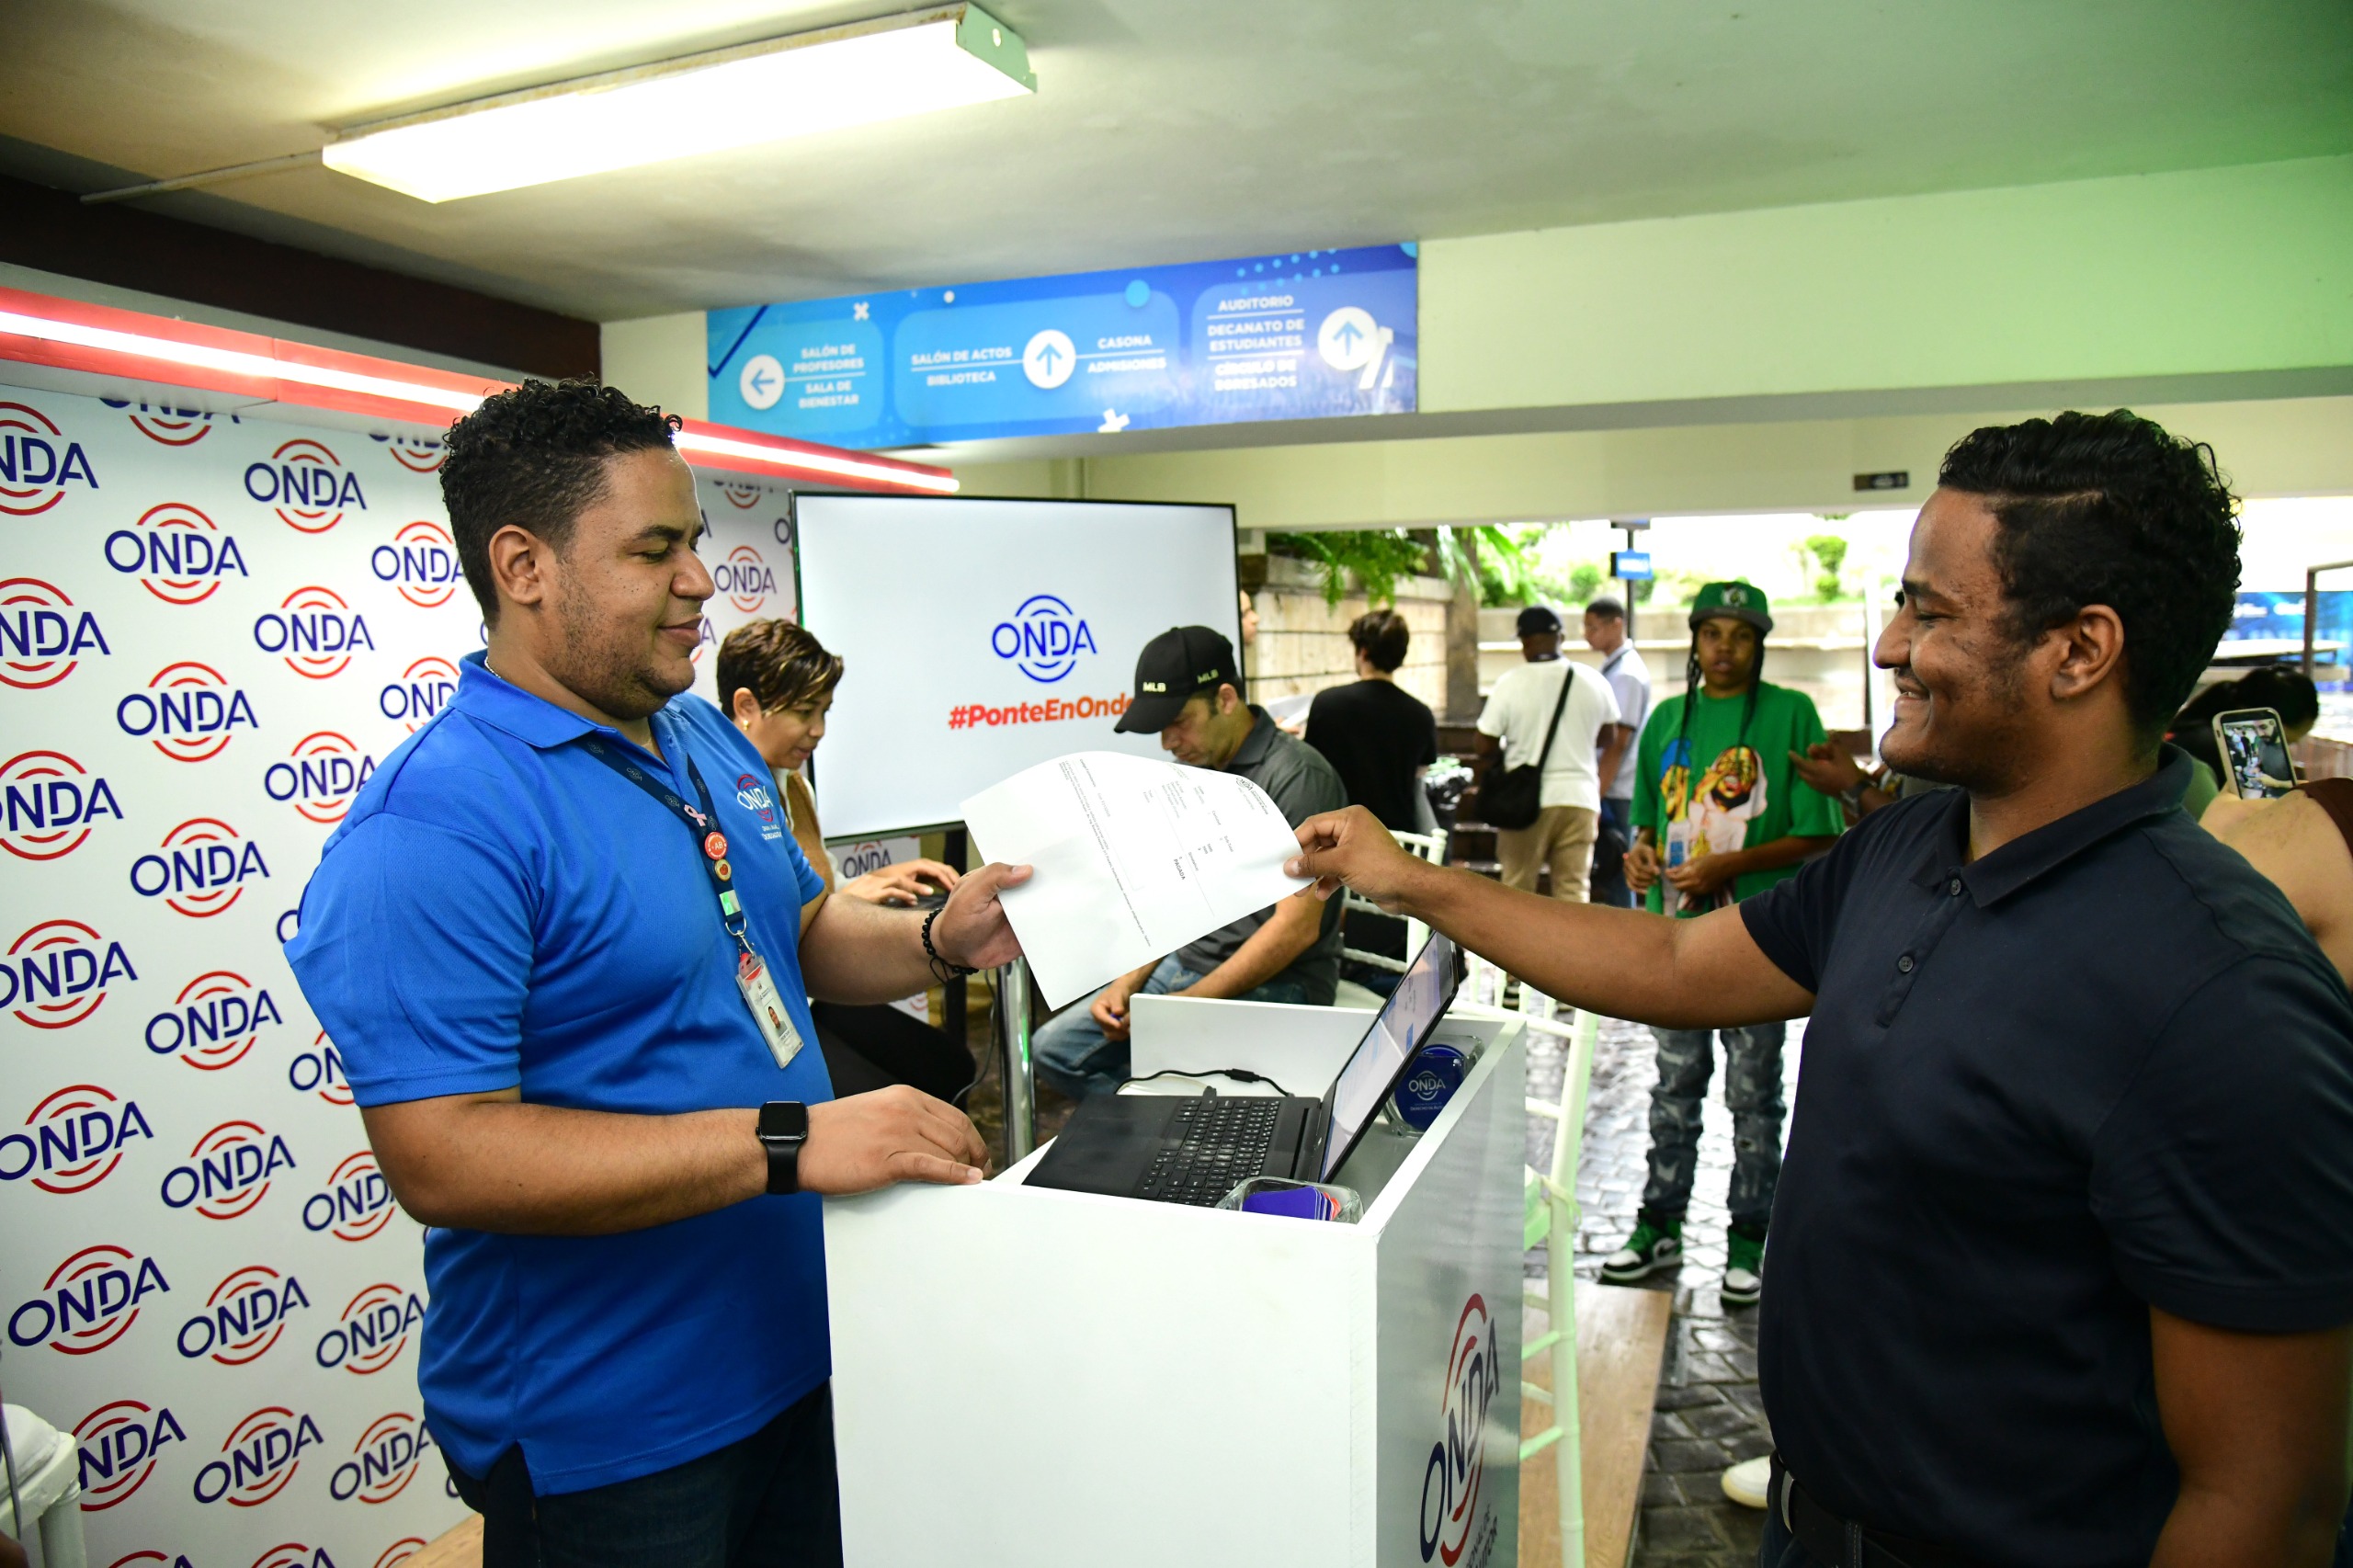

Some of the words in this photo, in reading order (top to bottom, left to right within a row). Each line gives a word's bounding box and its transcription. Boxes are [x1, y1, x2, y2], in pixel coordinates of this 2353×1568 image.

[1218, 295, 1294, 312] AUDITORIO
[1097, 334, 1153, 349] CASONA
[1207, 320, 1283, 336] DECANATO
[1285, 318, 1305, 331] DE
[1210, 335, 1302, 352] ESTUDIANTES
[793, 358, 864, 373] PROFESORES
[801, 344, 839, 359] SALÓN
[840, 343, 856, 356] DE
[912, 349, 951, 365] SALÓN
[953, 350, 970, 362] DE
[972, 347, 1013, 360] ACTOS
[1277, 358, 1297, 372] DE
[806, 381, 835, 394] SALA
[836, 380, 852, 392] DE
[926, 370, 996, 386] BIBLIOTECA
[1214, 375, 1297, 392] EGRESADOS
[799, 394, 859, 409] BIENESTAR
[245, 462, 367, 510] ONDA
[105, 530, 248, 577] ONDA
[714, 565, 777, 594] ONDA
[0, 610, 111, 656] NDA
[254, 613, 375, 653] ONDA
[992, 619, 1097, 659] ONDA
[1142, 681, 1166, 692] MLB
[117, 689, 259, 736] ONDA
[0, 778, 124, 832] NDA
[737, 786, 774, 810] ONDA
[131, 841, 270, 897] ONDA
[145, 989, 283, 1054] ONDA
[1408, 1078, 1446, 1092] ONDA
[0, 1101, 154, 1181] ONDA
[162, 1135, 296, 1209] ONDA
[303, 1173, 394, 1232] OND
[9, 1256, 170, 1346] ONDA
[177, 1277, 311, 1358] ONDA
[316, 1293, 426, 1369] ONDA
[78, 1407, 188, 1491] NDA
[193, 1414, 324, 1504] ONDA
[1420, 1317, 1499, 1563] ONDA
